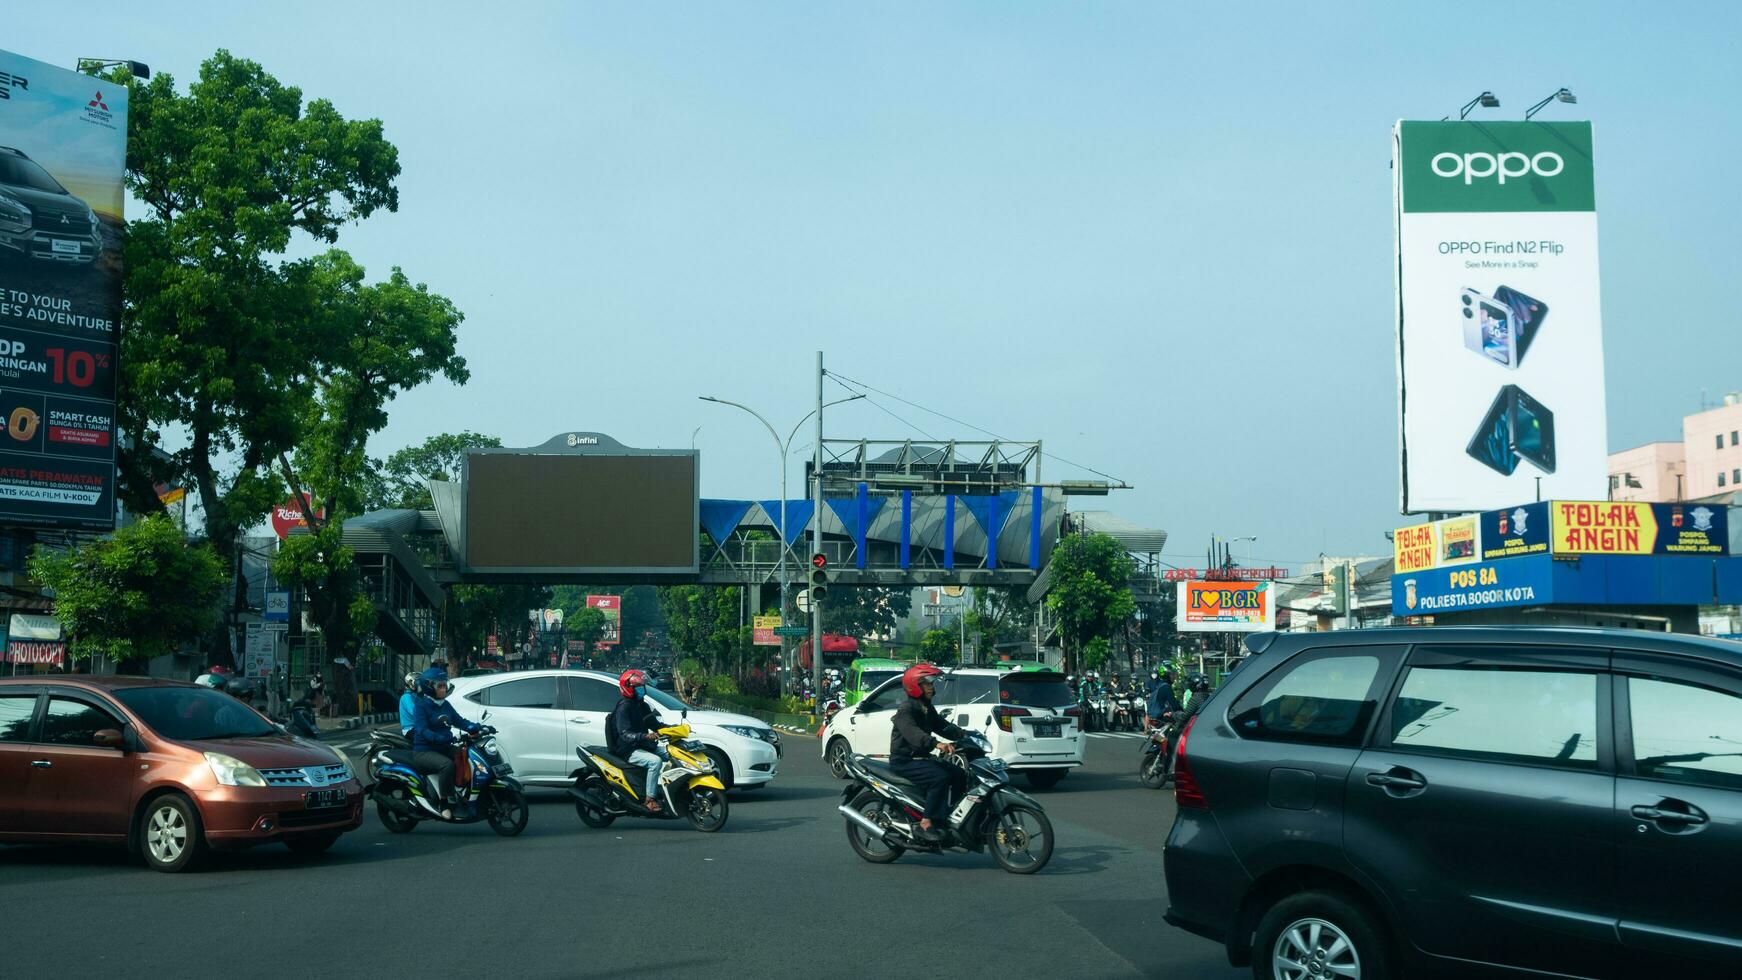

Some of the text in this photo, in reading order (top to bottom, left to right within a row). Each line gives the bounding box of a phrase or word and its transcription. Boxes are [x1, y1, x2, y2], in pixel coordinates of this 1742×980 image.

[1438, 240, 1564, 256] OPPO Find N2 Flip
[1464, 260, 1480, 269] See
[1481, 260, 1501, 269] More
[1504, 260, 1511, 269] in
[1518, 260, 1538, 270] Snap
[10, 290, 28, 304] TO
[32, 294, 71, 311] YOUR
[27, 308, 112, 331] ADVENTURE
[0, 340, 26, 356] DP
[50, 411, 110, 425] SMART CASH
[50, 419, 72, 427] BUNGA
[12, 479, 29, 487] SPARE
[19, 489, 40, 498] KACA
[42, 491, 61, 499] FILM
[1561, 504, 1640, 527] TOLAK
[1397, 526, 1431, 549] TOLAK
[1566, 528, 1640, 551] ANGIN
[1399, 547, 1431, 569] ANGIN
[1450, 567, 1497, 588] POS 8A
[1191, 589, 1260, 608] I BGR
[1420, 587, 1535, 609] POLRESTA BOGOR KOTA
[9, 642, 63, 663] PHOTOCOPY
